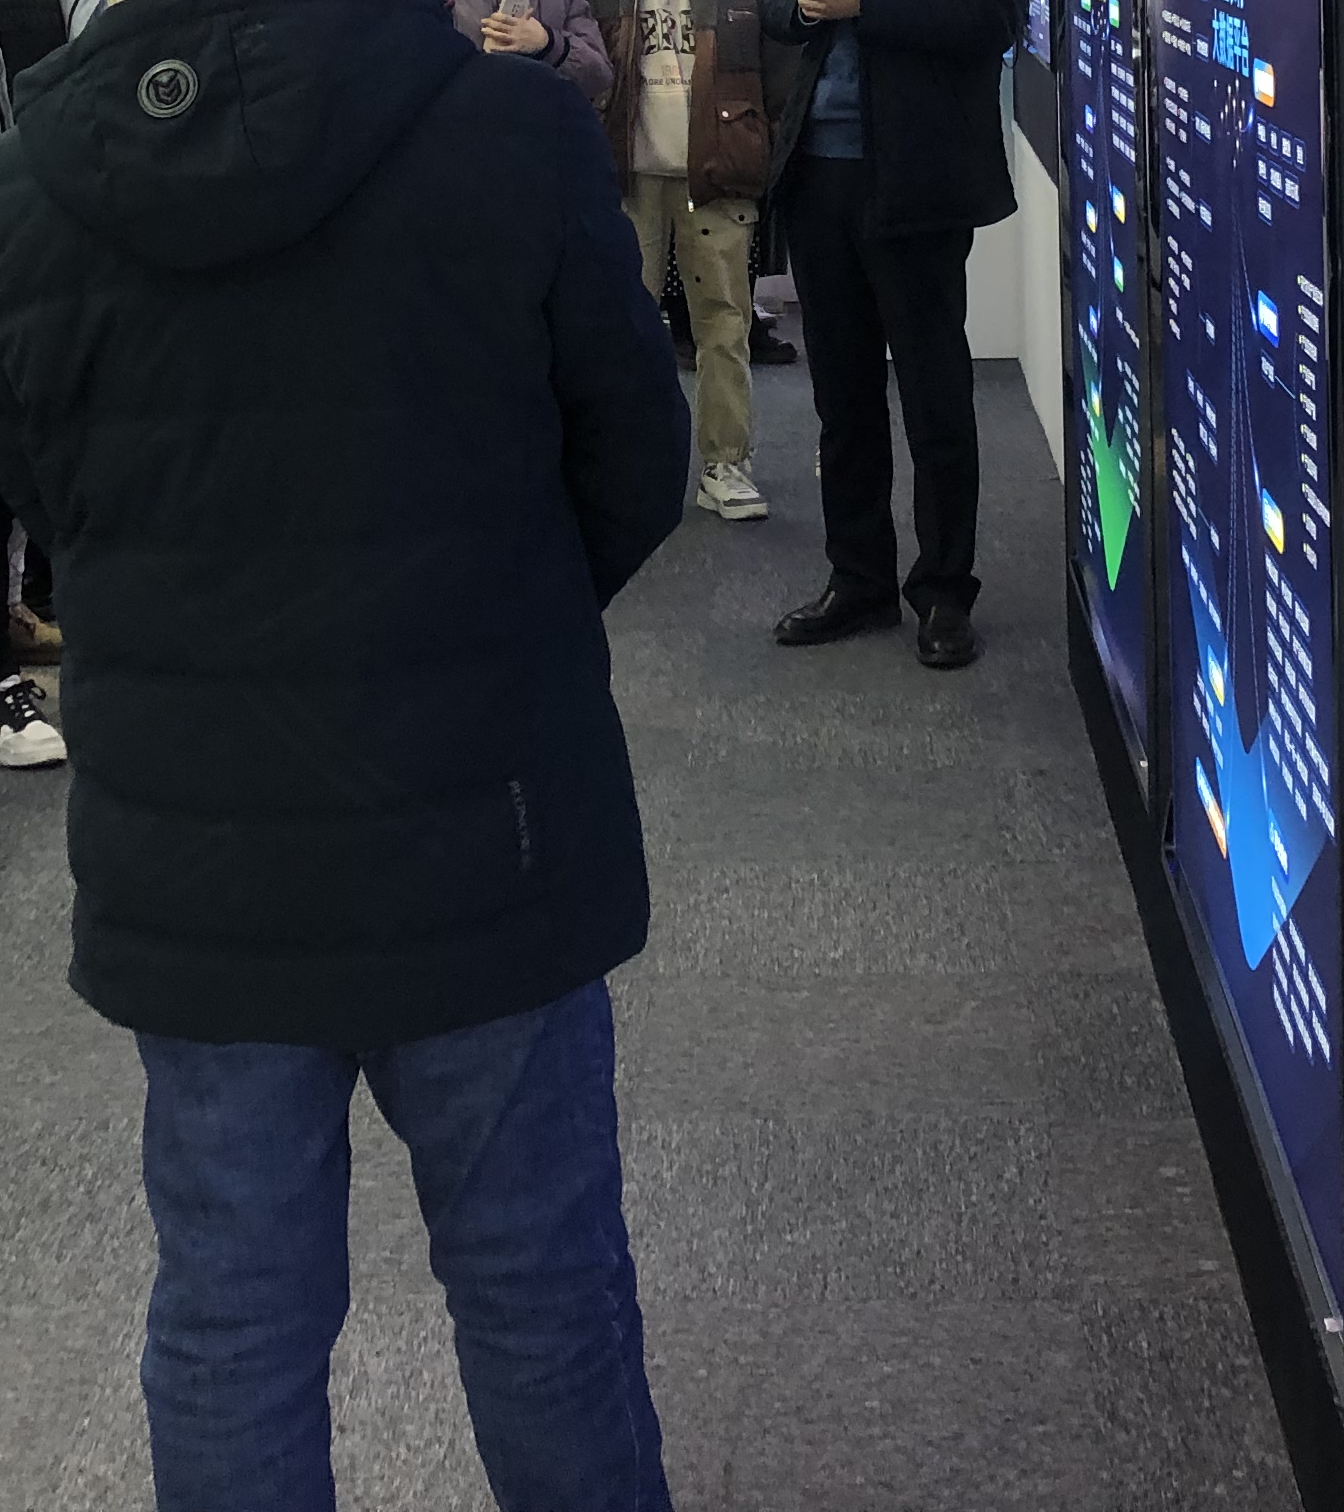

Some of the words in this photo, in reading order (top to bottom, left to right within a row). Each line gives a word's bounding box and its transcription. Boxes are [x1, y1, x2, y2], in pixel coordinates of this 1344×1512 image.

[1211, 7, 1251, 79] 大数据平台
